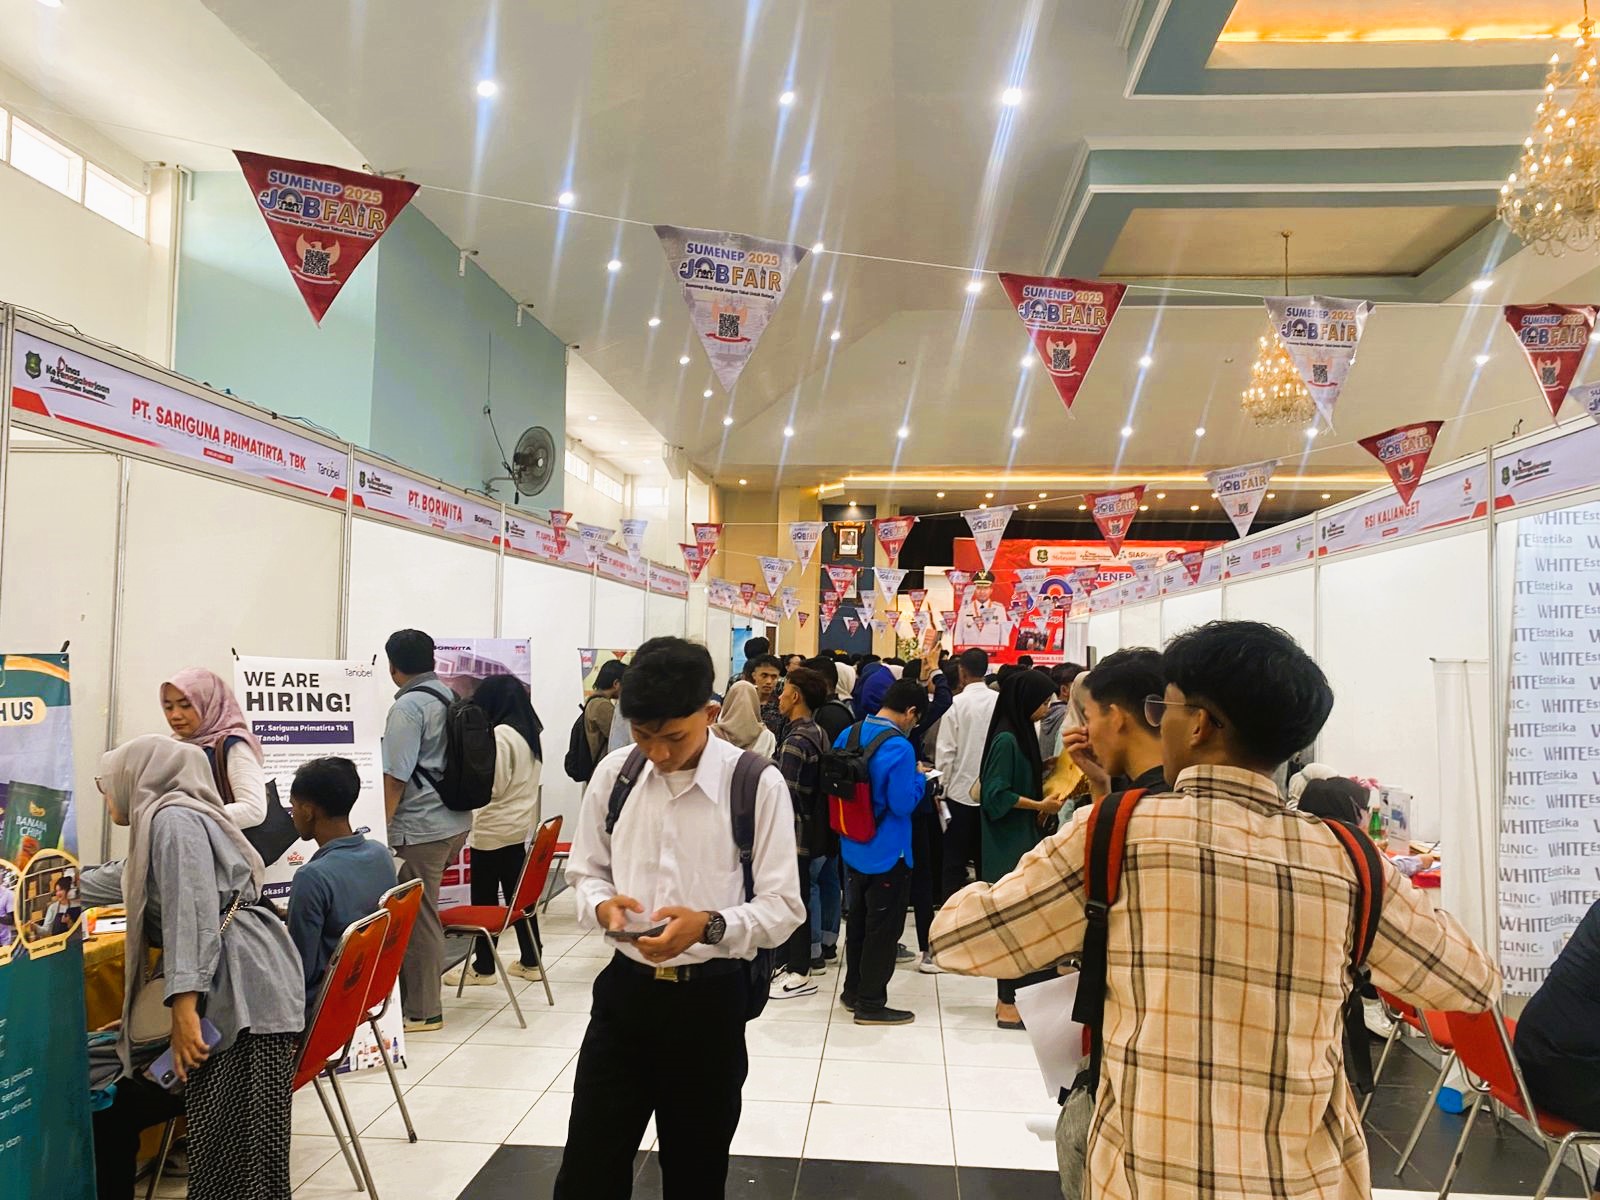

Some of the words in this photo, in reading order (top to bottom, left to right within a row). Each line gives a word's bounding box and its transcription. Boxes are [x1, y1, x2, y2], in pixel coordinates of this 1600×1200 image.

[269, 171, 341, 194] SUMENEP
[345, 188, 382, 203] 2025
[687, 243, 744, 261] SUMENEP
[749, 252, 778, 266] 2025
[1023, 286, 1073, 300] SUMENEP
[1076, 291, 1103, 303] 2025
[1331, 310, 1355, 320] 2025
[132, 397, 151, 419] PT.
[156, 406, 220, 442] SARIGUNA
[223, 429, 287, 465] PRIMATIRTA,
[289, 452, 306, 470] TBK
[408, 490, 420, 508] PT.
[422, 495, 463, 522] BORWITA
[1365, 514, 1375, 528] RSI
[1377, 500, 1420, 523] KALIANGET
[1533, 511, 1582, 526] WHITE
[1535, 558, 1584, 572] WHITE
[1095, 572, 1132, 582] MENEP
[1534, 581, 1573, 591] Estetika
[1538, 604, 1585, 619] WHITE
[1514, 627, 1537, 642] ITE
[1536, 628, 1574, 638] Estetika
[1540, 651, 1585, 667] WHITE
[244, 671, 276, 687] WE
[281, 672, 320, 688] ARE
[1539, 675, 1575, 685] Estetika
[246, 691, 351, 712] HIRING!
[1542, 698, 1587, 713] WHITE
[11, 701, 33, 721] US
[254, 724, 267, 732] PT.
[268, 724, 299, 733] Sariguna
[300, 724, 335, 732] Primatirta
[336, 724, 349, 732] Tbk
[1508, 723, 1541, 738] HITE
[1541, 722, 1576, 733] Estetika
[257, 734, 290, 743] Tanobel)
[1544, 746, 1588, 761] WHITE
[1508, 770, 1543, 786] HITE
[1543, 770, 1578, 781] Estetika
[1546, 793, 1589, 809] WHITE
[16, 815, 47, 830] BANANA
[19, 826, 43, 840] CHIPS
[1548, 841, 1590, 857] WHITE
[1500, 867, 1548, 883] WHITE
[263, 885, 283, 896] okasi
[1550, 890, 1592, 906] WHITE
[1500, 915, 1550, 933] WHITE
